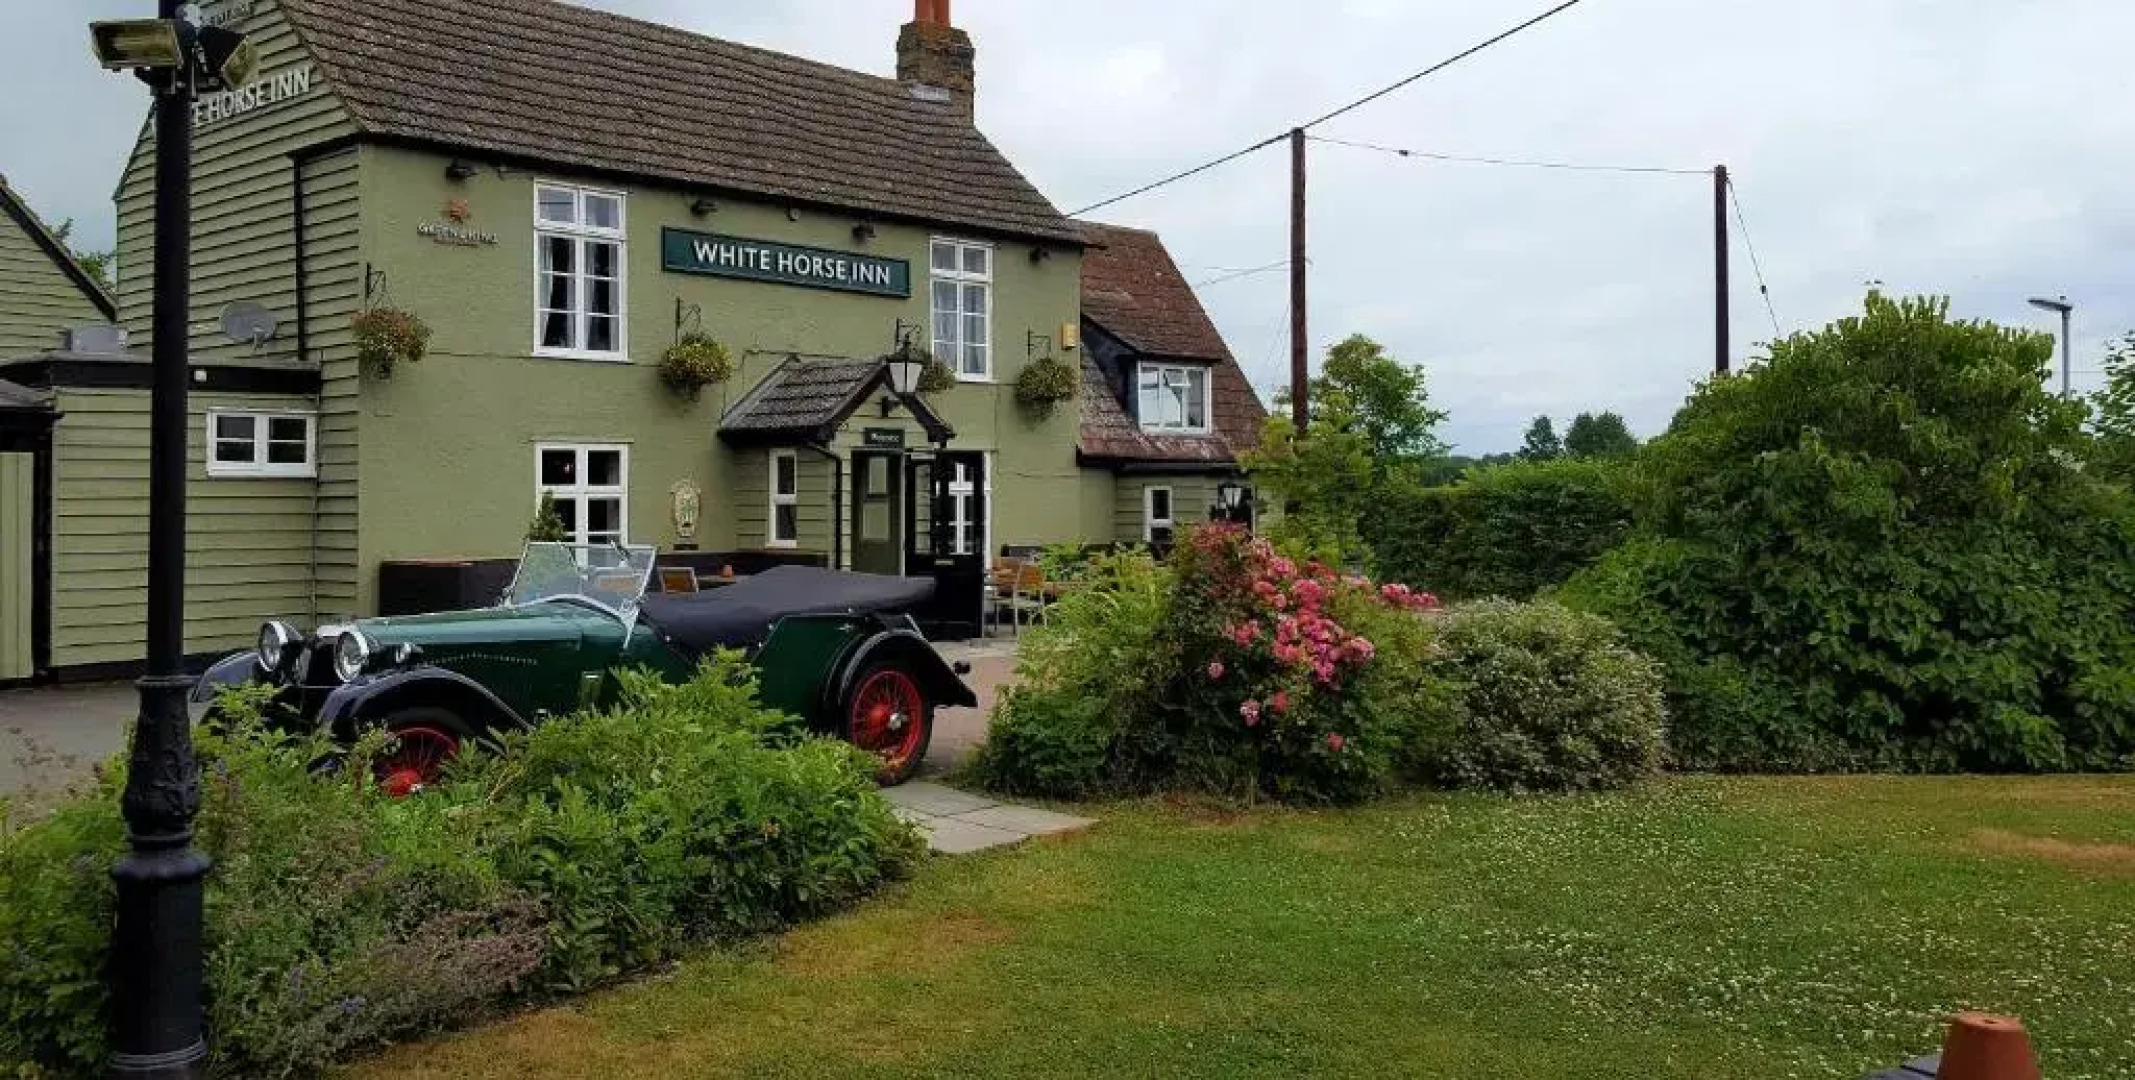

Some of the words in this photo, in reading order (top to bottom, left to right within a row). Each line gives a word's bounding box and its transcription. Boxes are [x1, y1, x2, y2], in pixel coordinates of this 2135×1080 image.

[208, 81, 266, 120] HORSE
[270, 66, 310, 102] INN
[693, 239, 771, 270] WHITE
[777, 251, 849, 280] HORSE
[851, 262, 891, 285] INN
